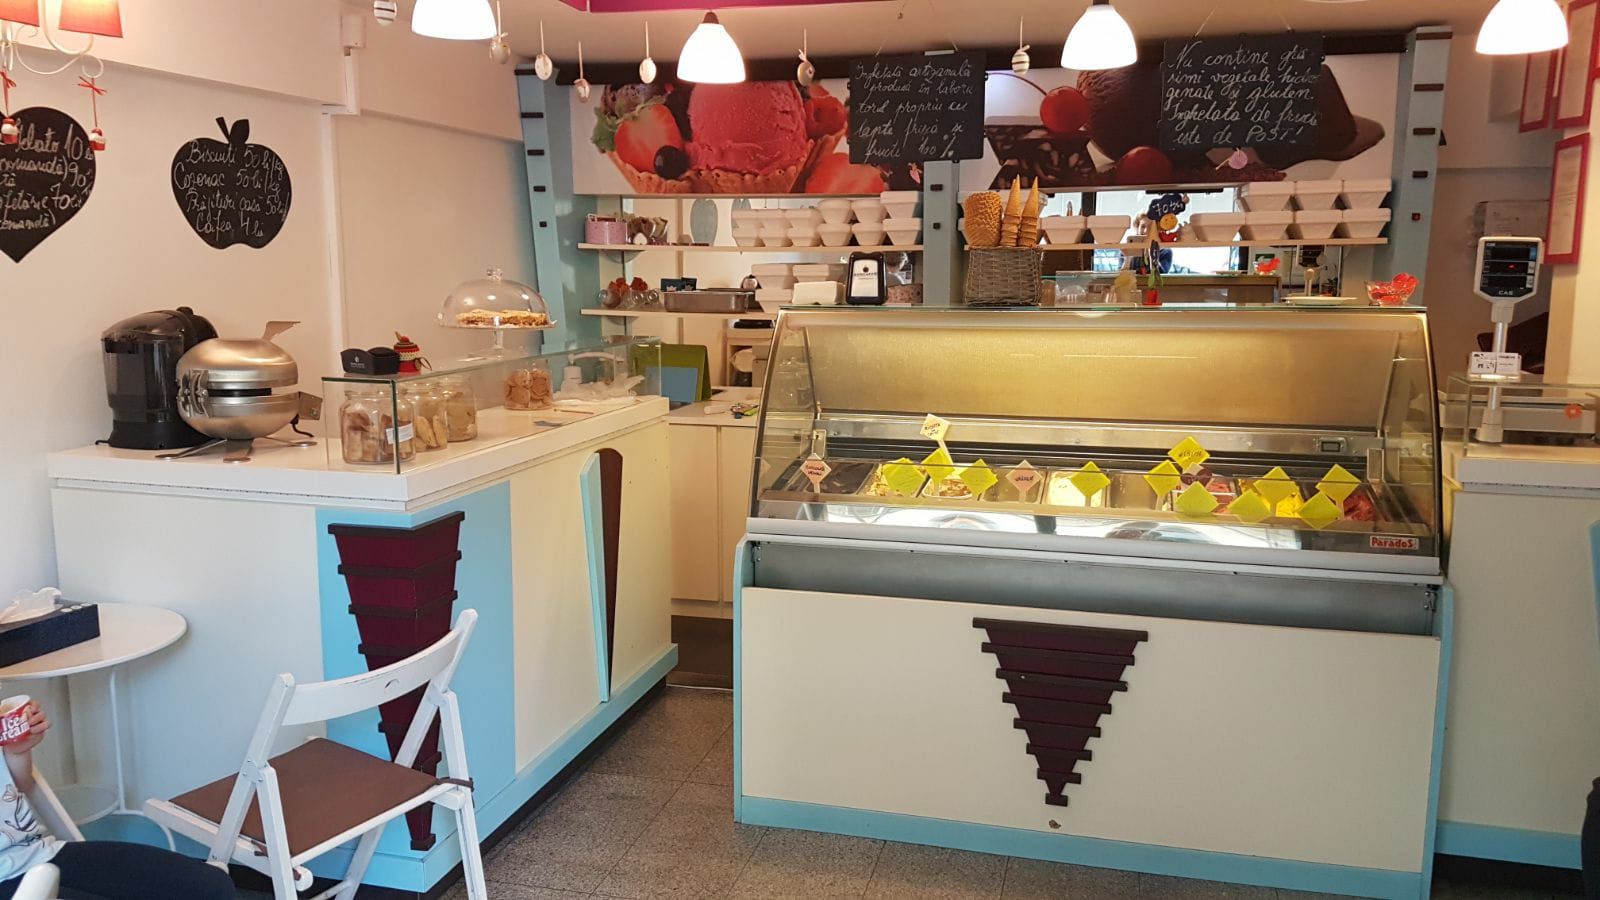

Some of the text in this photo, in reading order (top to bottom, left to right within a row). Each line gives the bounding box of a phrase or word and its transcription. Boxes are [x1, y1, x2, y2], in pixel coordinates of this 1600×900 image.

[1250, 102, 1271, 122] de
[1211, 124, 1233, 145] de
[2, 716, 20, 731] Ice
